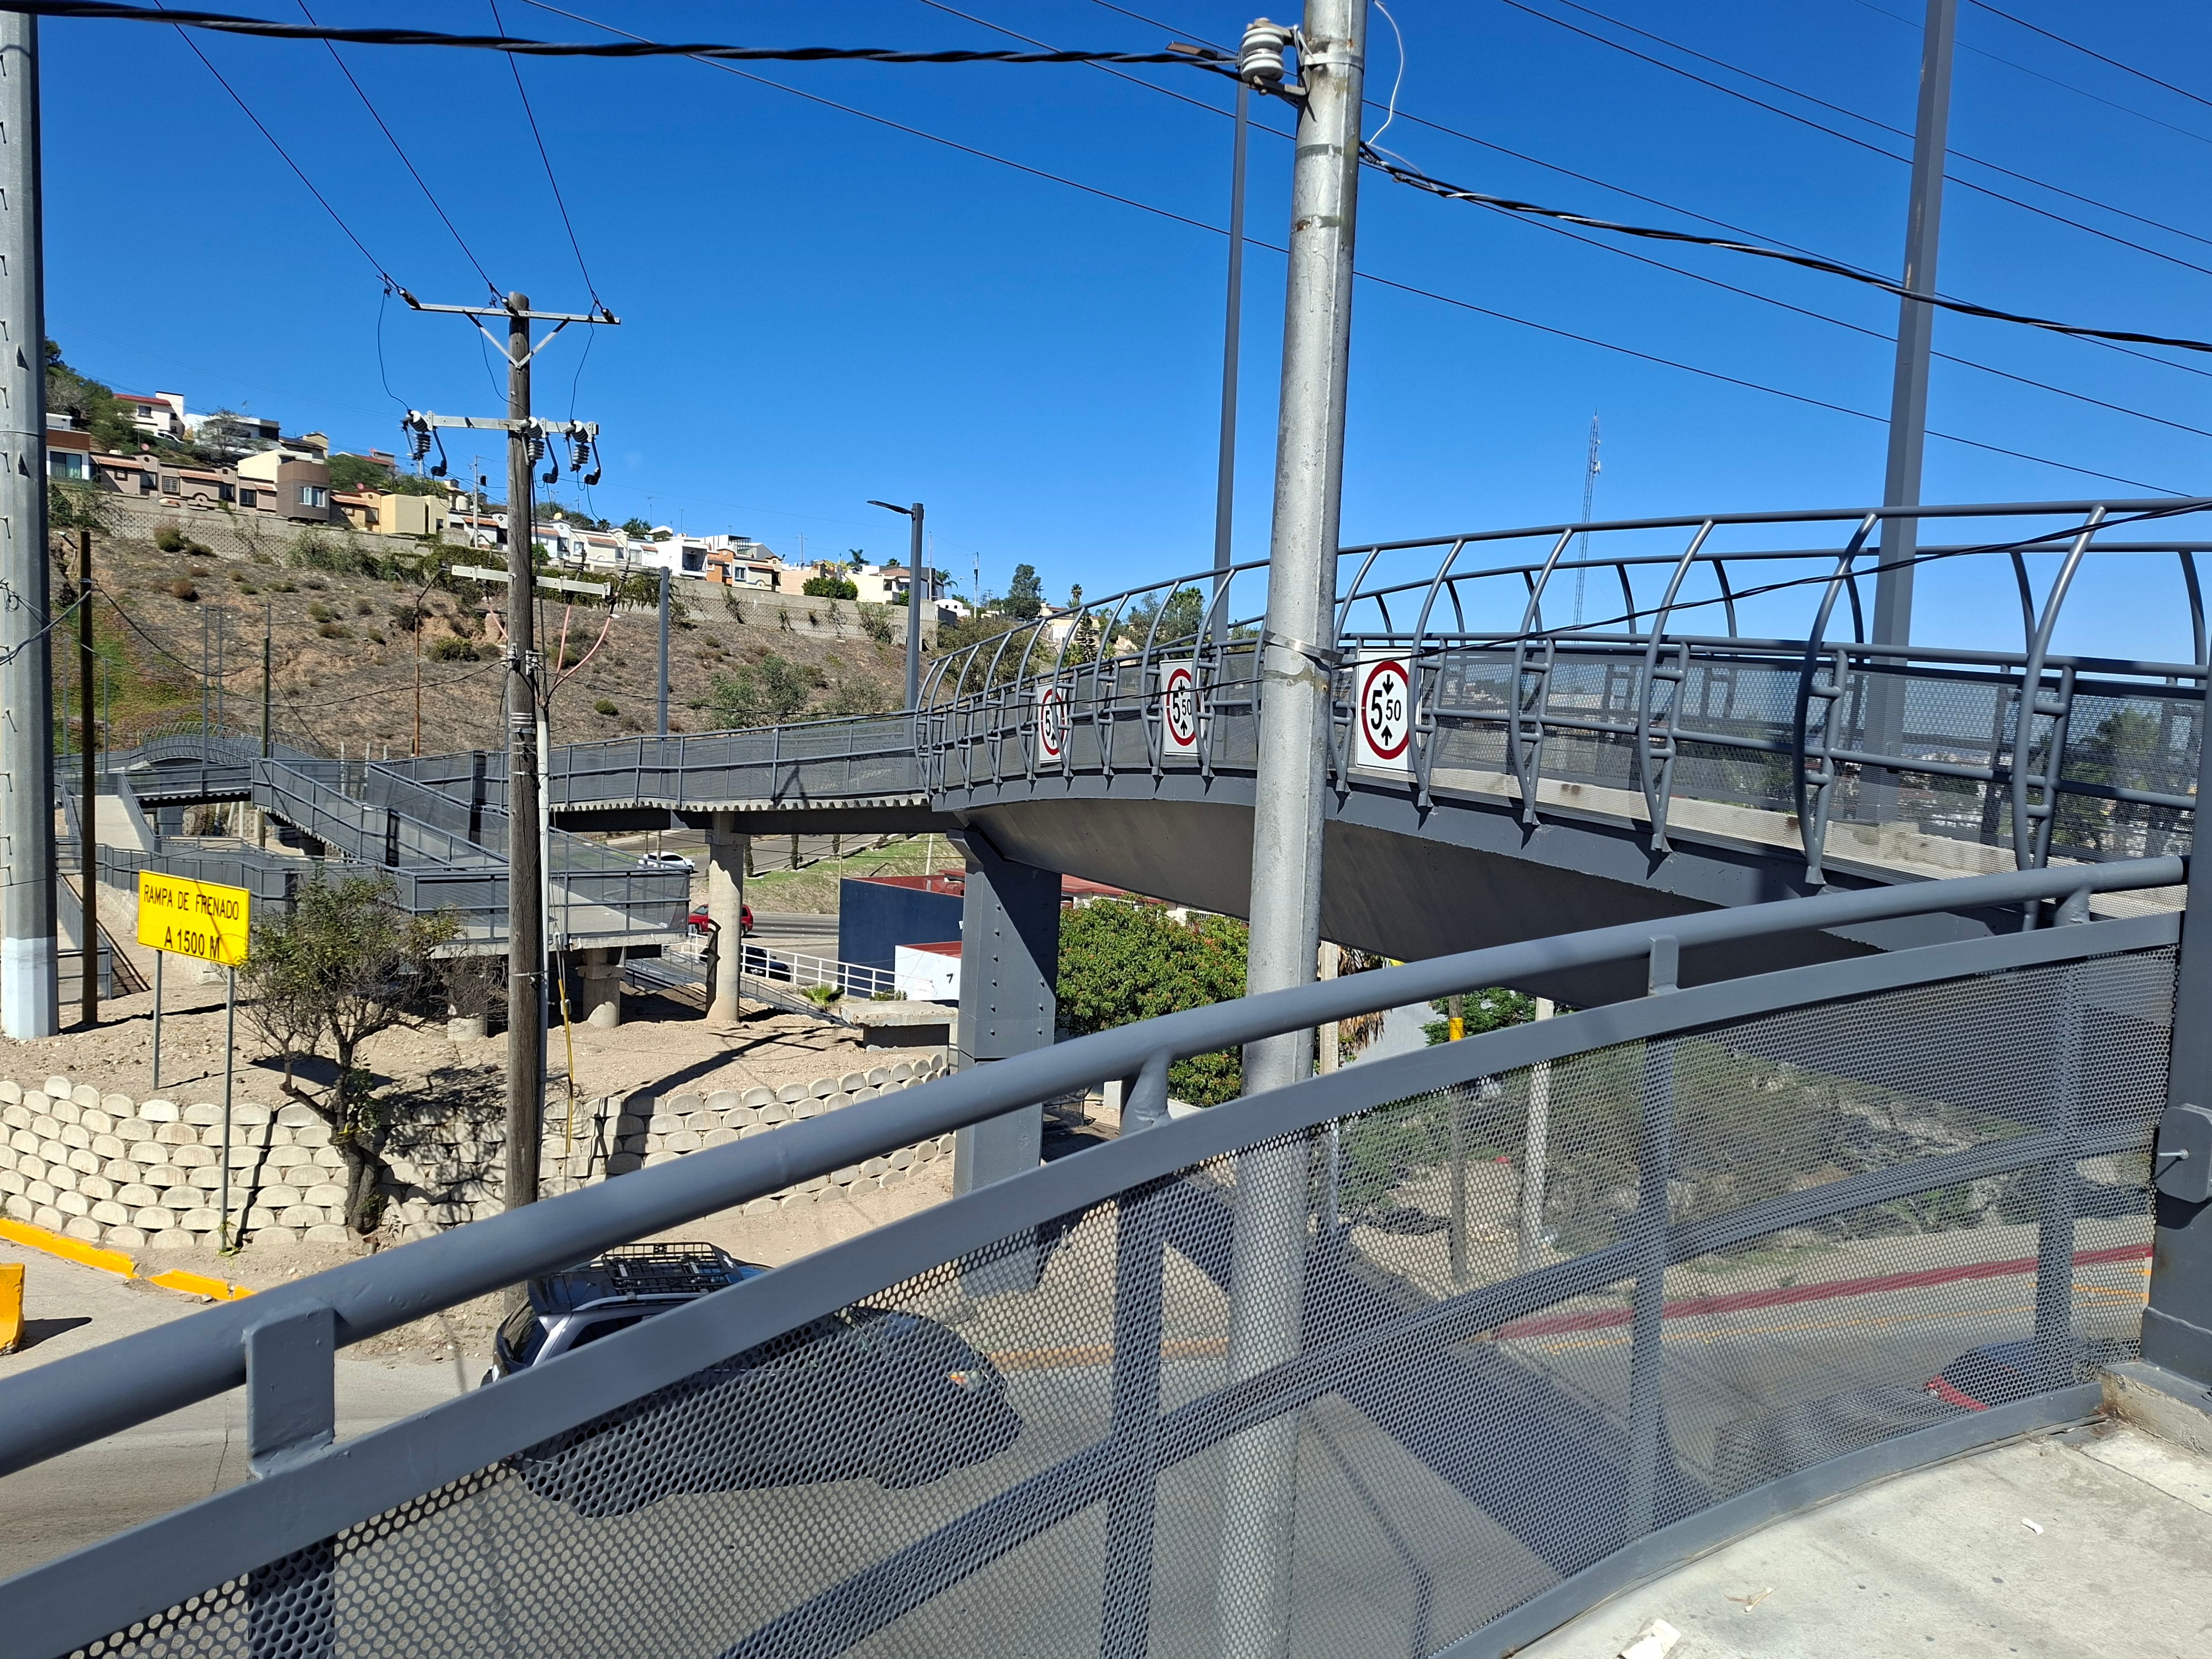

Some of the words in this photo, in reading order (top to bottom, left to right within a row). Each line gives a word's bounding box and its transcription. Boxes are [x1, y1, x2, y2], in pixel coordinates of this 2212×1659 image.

[144, 884, 173, 908] RAMPA
[178, 891, 189, 911] DE
[196, 894, 239, 920] FRENADO
[164, 926, 173, 949] A
[177, 928, 205, 956] 1500
[210, 935, 220, 960] M
